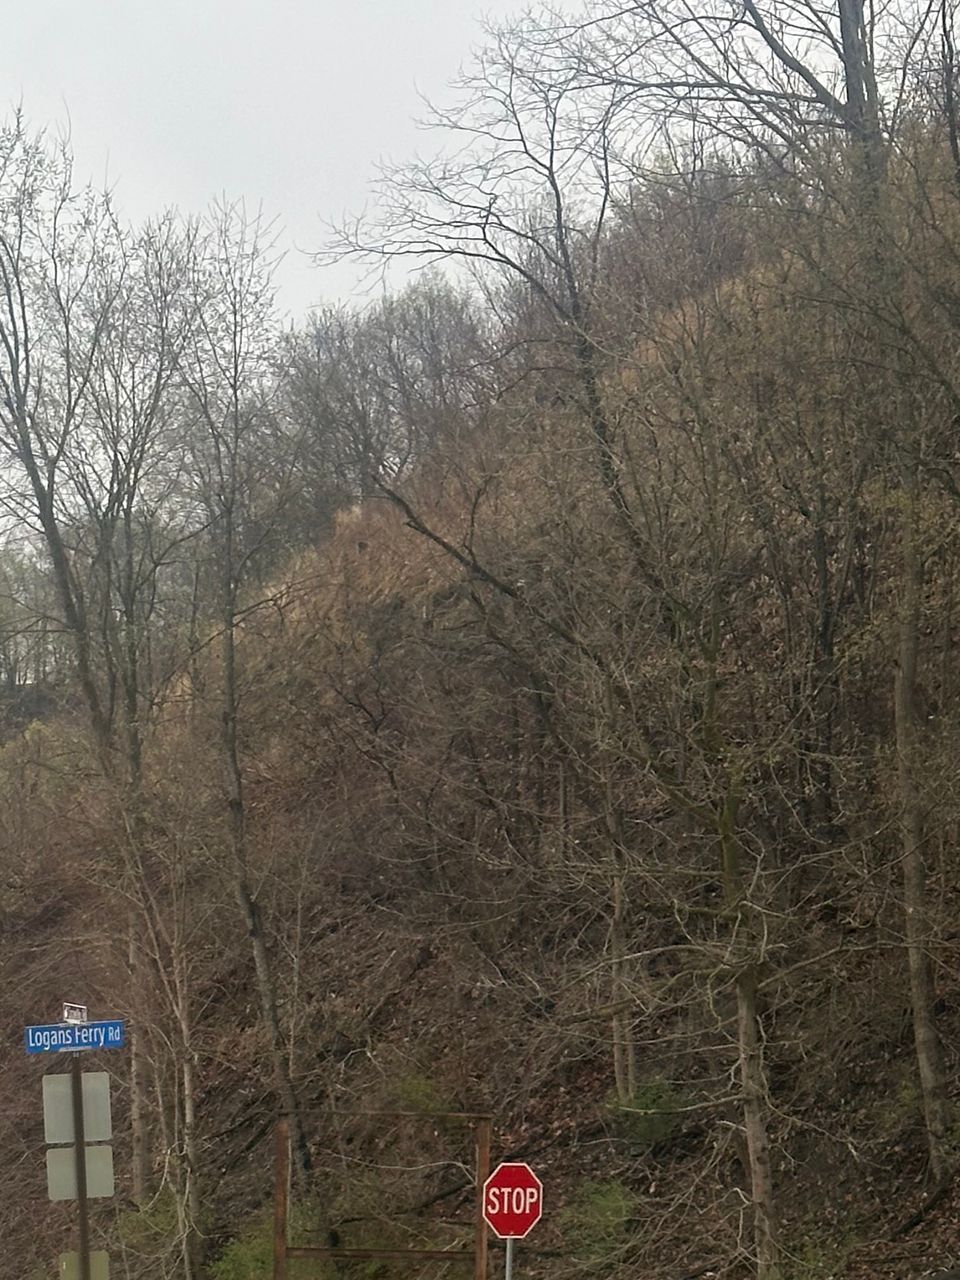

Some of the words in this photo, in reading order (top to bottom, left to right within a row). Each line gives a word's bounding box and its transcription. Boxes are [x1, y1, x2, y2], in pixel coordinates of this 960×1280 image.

[28, 1028, 73, 1051] Logans
[75, 1026, 106, 1047] Ferry
[108, 1026, 121, 1041] Rd
[487, 1187, 539, 1214] STOP
